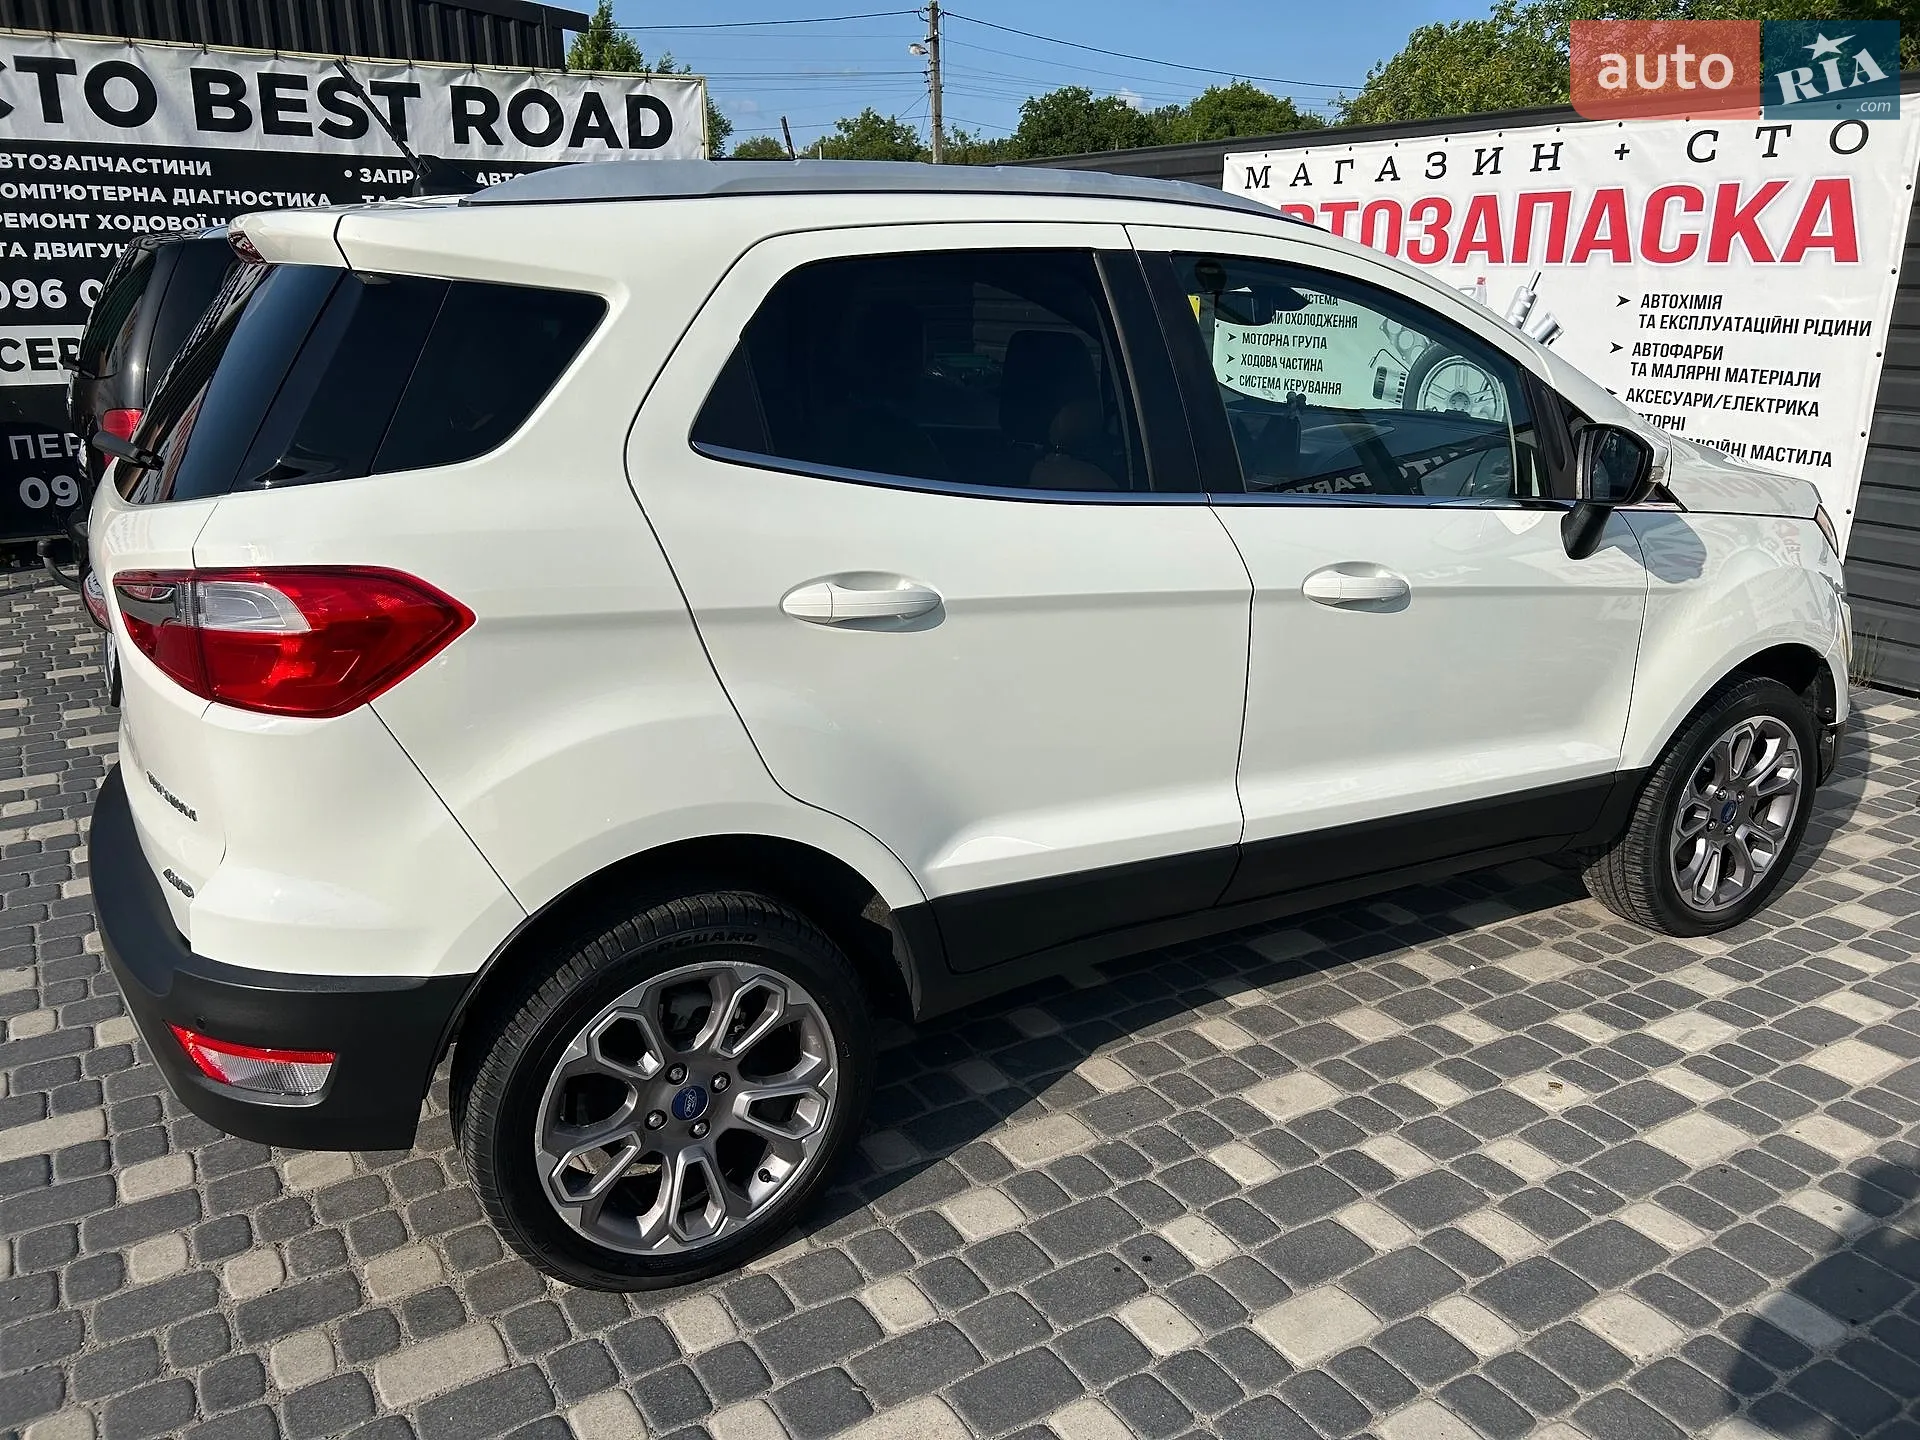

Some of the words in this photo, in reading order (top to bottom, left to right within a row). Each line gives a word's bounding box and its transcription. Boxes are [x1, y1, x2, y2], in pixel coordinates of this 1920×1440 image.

[0, 55, 158, 128] ТО
[190, 67, 421, 142] BEST
[450, 84, 674, 150] ROAD
[0, 152, 212, 177] ВТОЗАПЧАСТИНИ
[1244, 142, 1564, 189] МАГАЗИН
[1686, 119, 1870, 163] СТО
[359, 168, 420, 184] ЗАПР
[476, 171, 526, 187] АВТ
[173, 187, 331, 208] ДІАГНОСТИКА
[0, 212, 90, 229] ЕМОНТ
[97, 213, 207, 233] ХОДОВОЇ
[1640, 293, 1723, 310] АВТОХІМІЯ
[1285, 312, 1358, 329] ОХОЛОДЖЕННЯ
[1639, 313, 1656, 329] ТА
[1659, 315, 1799, 334] ЕКСПЛУАТАЦІЙНІ
[1803, 319, 1872, 337] РІДИНИ
[1242, 332, 1290, 348] МОТОРНА
[1292, 335, 1328, 350] ГРУПА
[1632, 342, 1724, 361] АВТОФАРБИ
[1240, 353, 1278, 369] ХОДОВА
[1279, 357, 1324, 373] ЧАСТИНА
[1239, 374, 1281, 391] СИСТЕМА
[1283, 379, 1342, 396] КЕРУВАННЯ
[1630, 362, 1647, 377] ТА
[1651, 363, 1721, 382] МАЛЯРНІ
[1725, 367, 1821, 388] МАТЕРІАЛИ
[1625, 387, 1820, 418] АКСЕСУАРИ/ЕЛЕКТРИКА
[1637, 412, 1686, 431] ТОРНІ
[1750, 444, 1832, 468] МАСТИЛА
